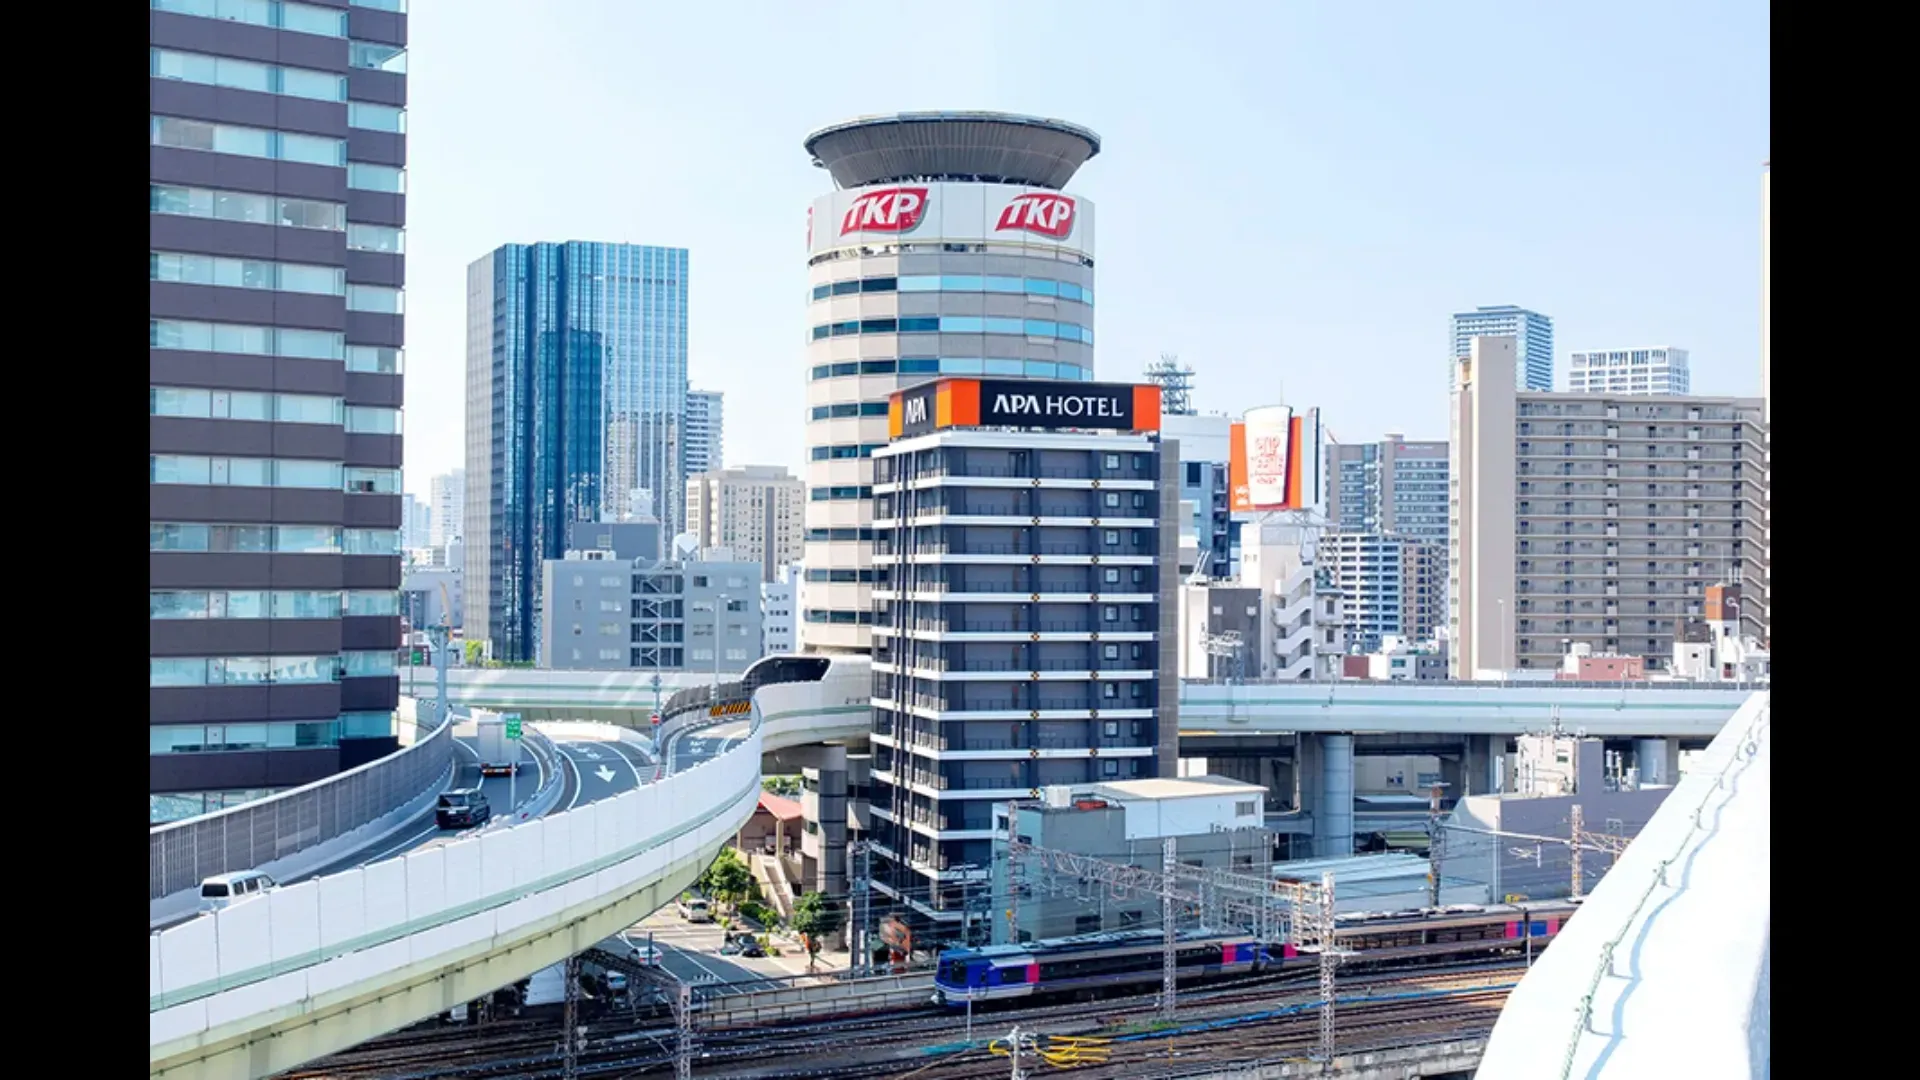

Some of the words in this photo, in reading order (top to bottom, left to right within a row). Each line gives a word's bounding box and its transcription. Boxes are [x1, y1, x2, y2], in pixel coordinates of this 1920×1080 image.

[848, 193, 919, 228] TKP
[1005, 198, 1070, 230] TKP
[905, 396, 926, 425] APA
[992, 394, 1041, 414] APA
[1045, 395, 1124, 417] HOTEL
